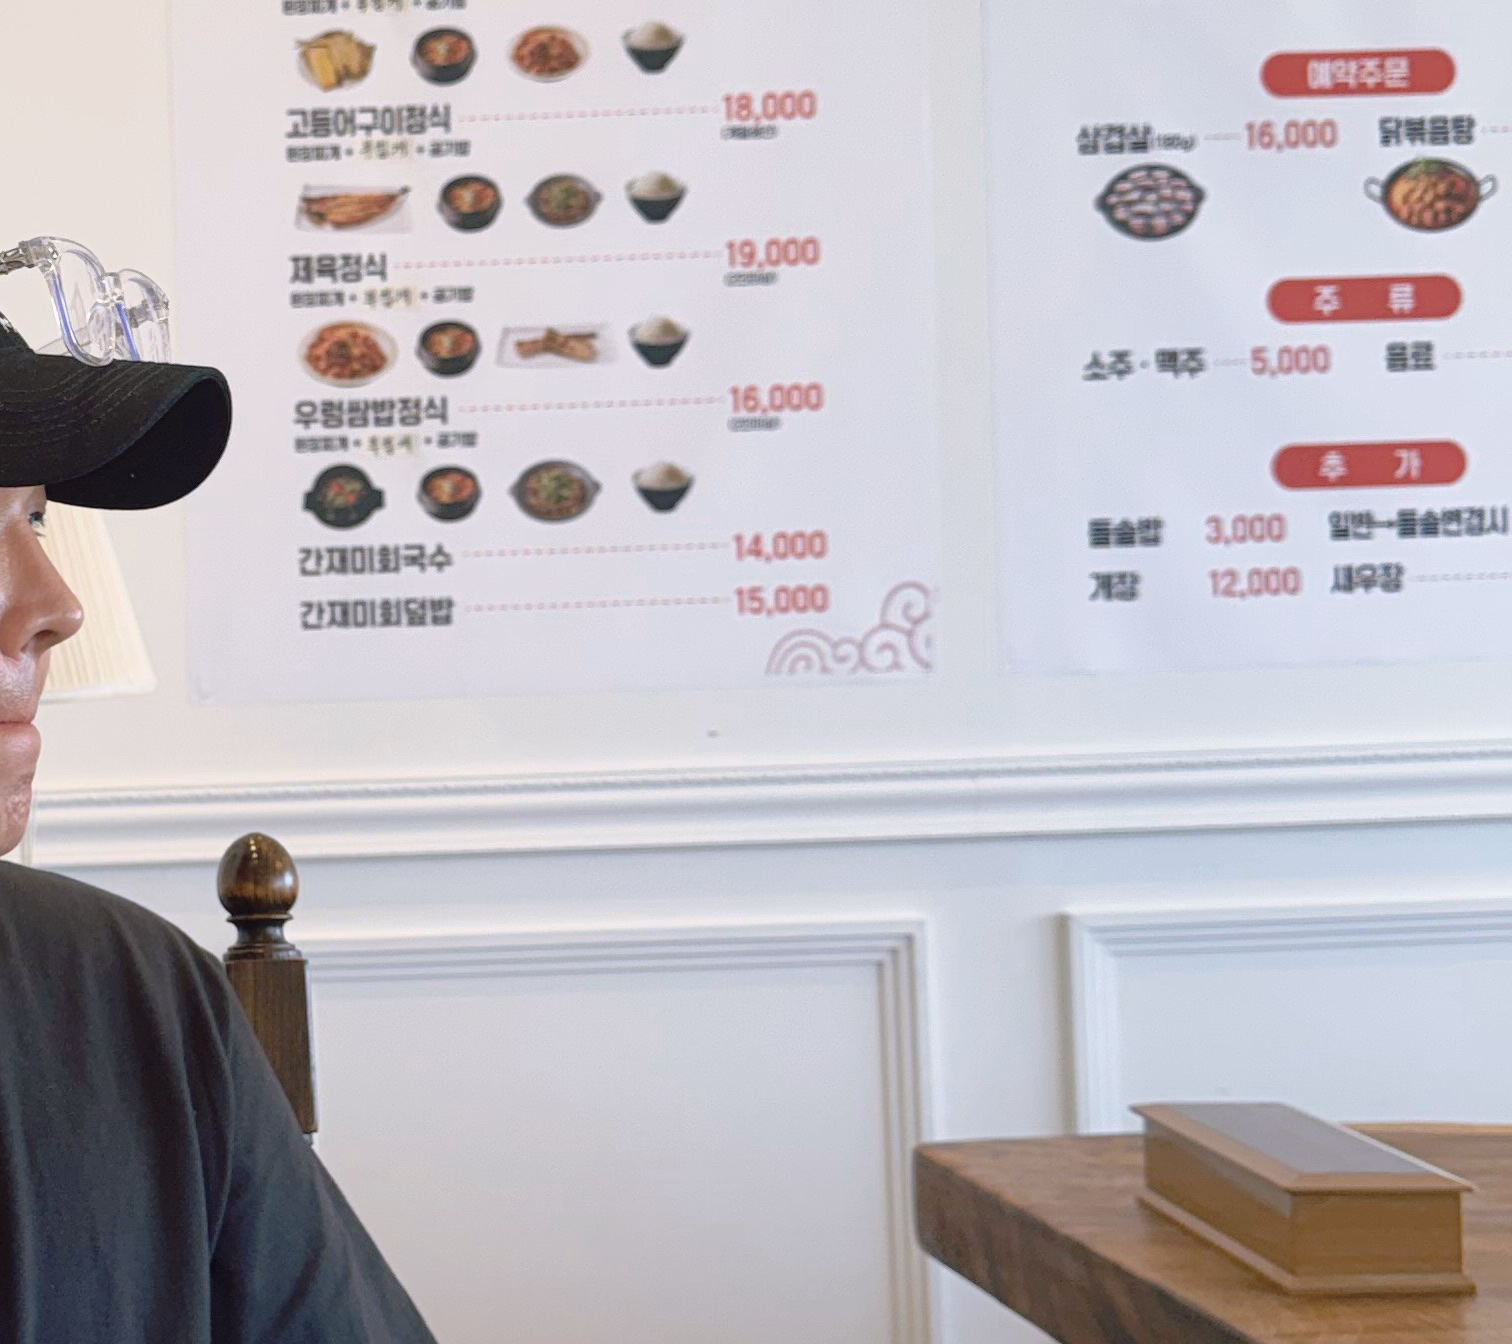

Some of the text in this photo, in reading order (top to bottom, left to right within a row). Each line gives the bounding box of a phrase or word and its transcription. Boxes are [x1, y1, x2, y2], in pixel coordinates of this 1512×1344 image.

[287, 90, 816, 138] 고등어구이정식 18,000
[1245, 119, 1338, 151] 16,000
[291, 237, 820, 283] 제육정식 19,000
[1084, 350, 1133, 381] 소주
[1251, 345, 1331, 377] 5,000
[1386, 342, 1433, 372] 음료
[295, 383, 823, 429] 우렁쌈밥정식 16,000
[1206, 514, 1286, 545] 3,000
[300, 530, 827, 576] 간재미회국수 14,000
[1210, 567, 1301, 599] 12,000
[301, 584, 829, 630] 간재미회덮밥 15,000
